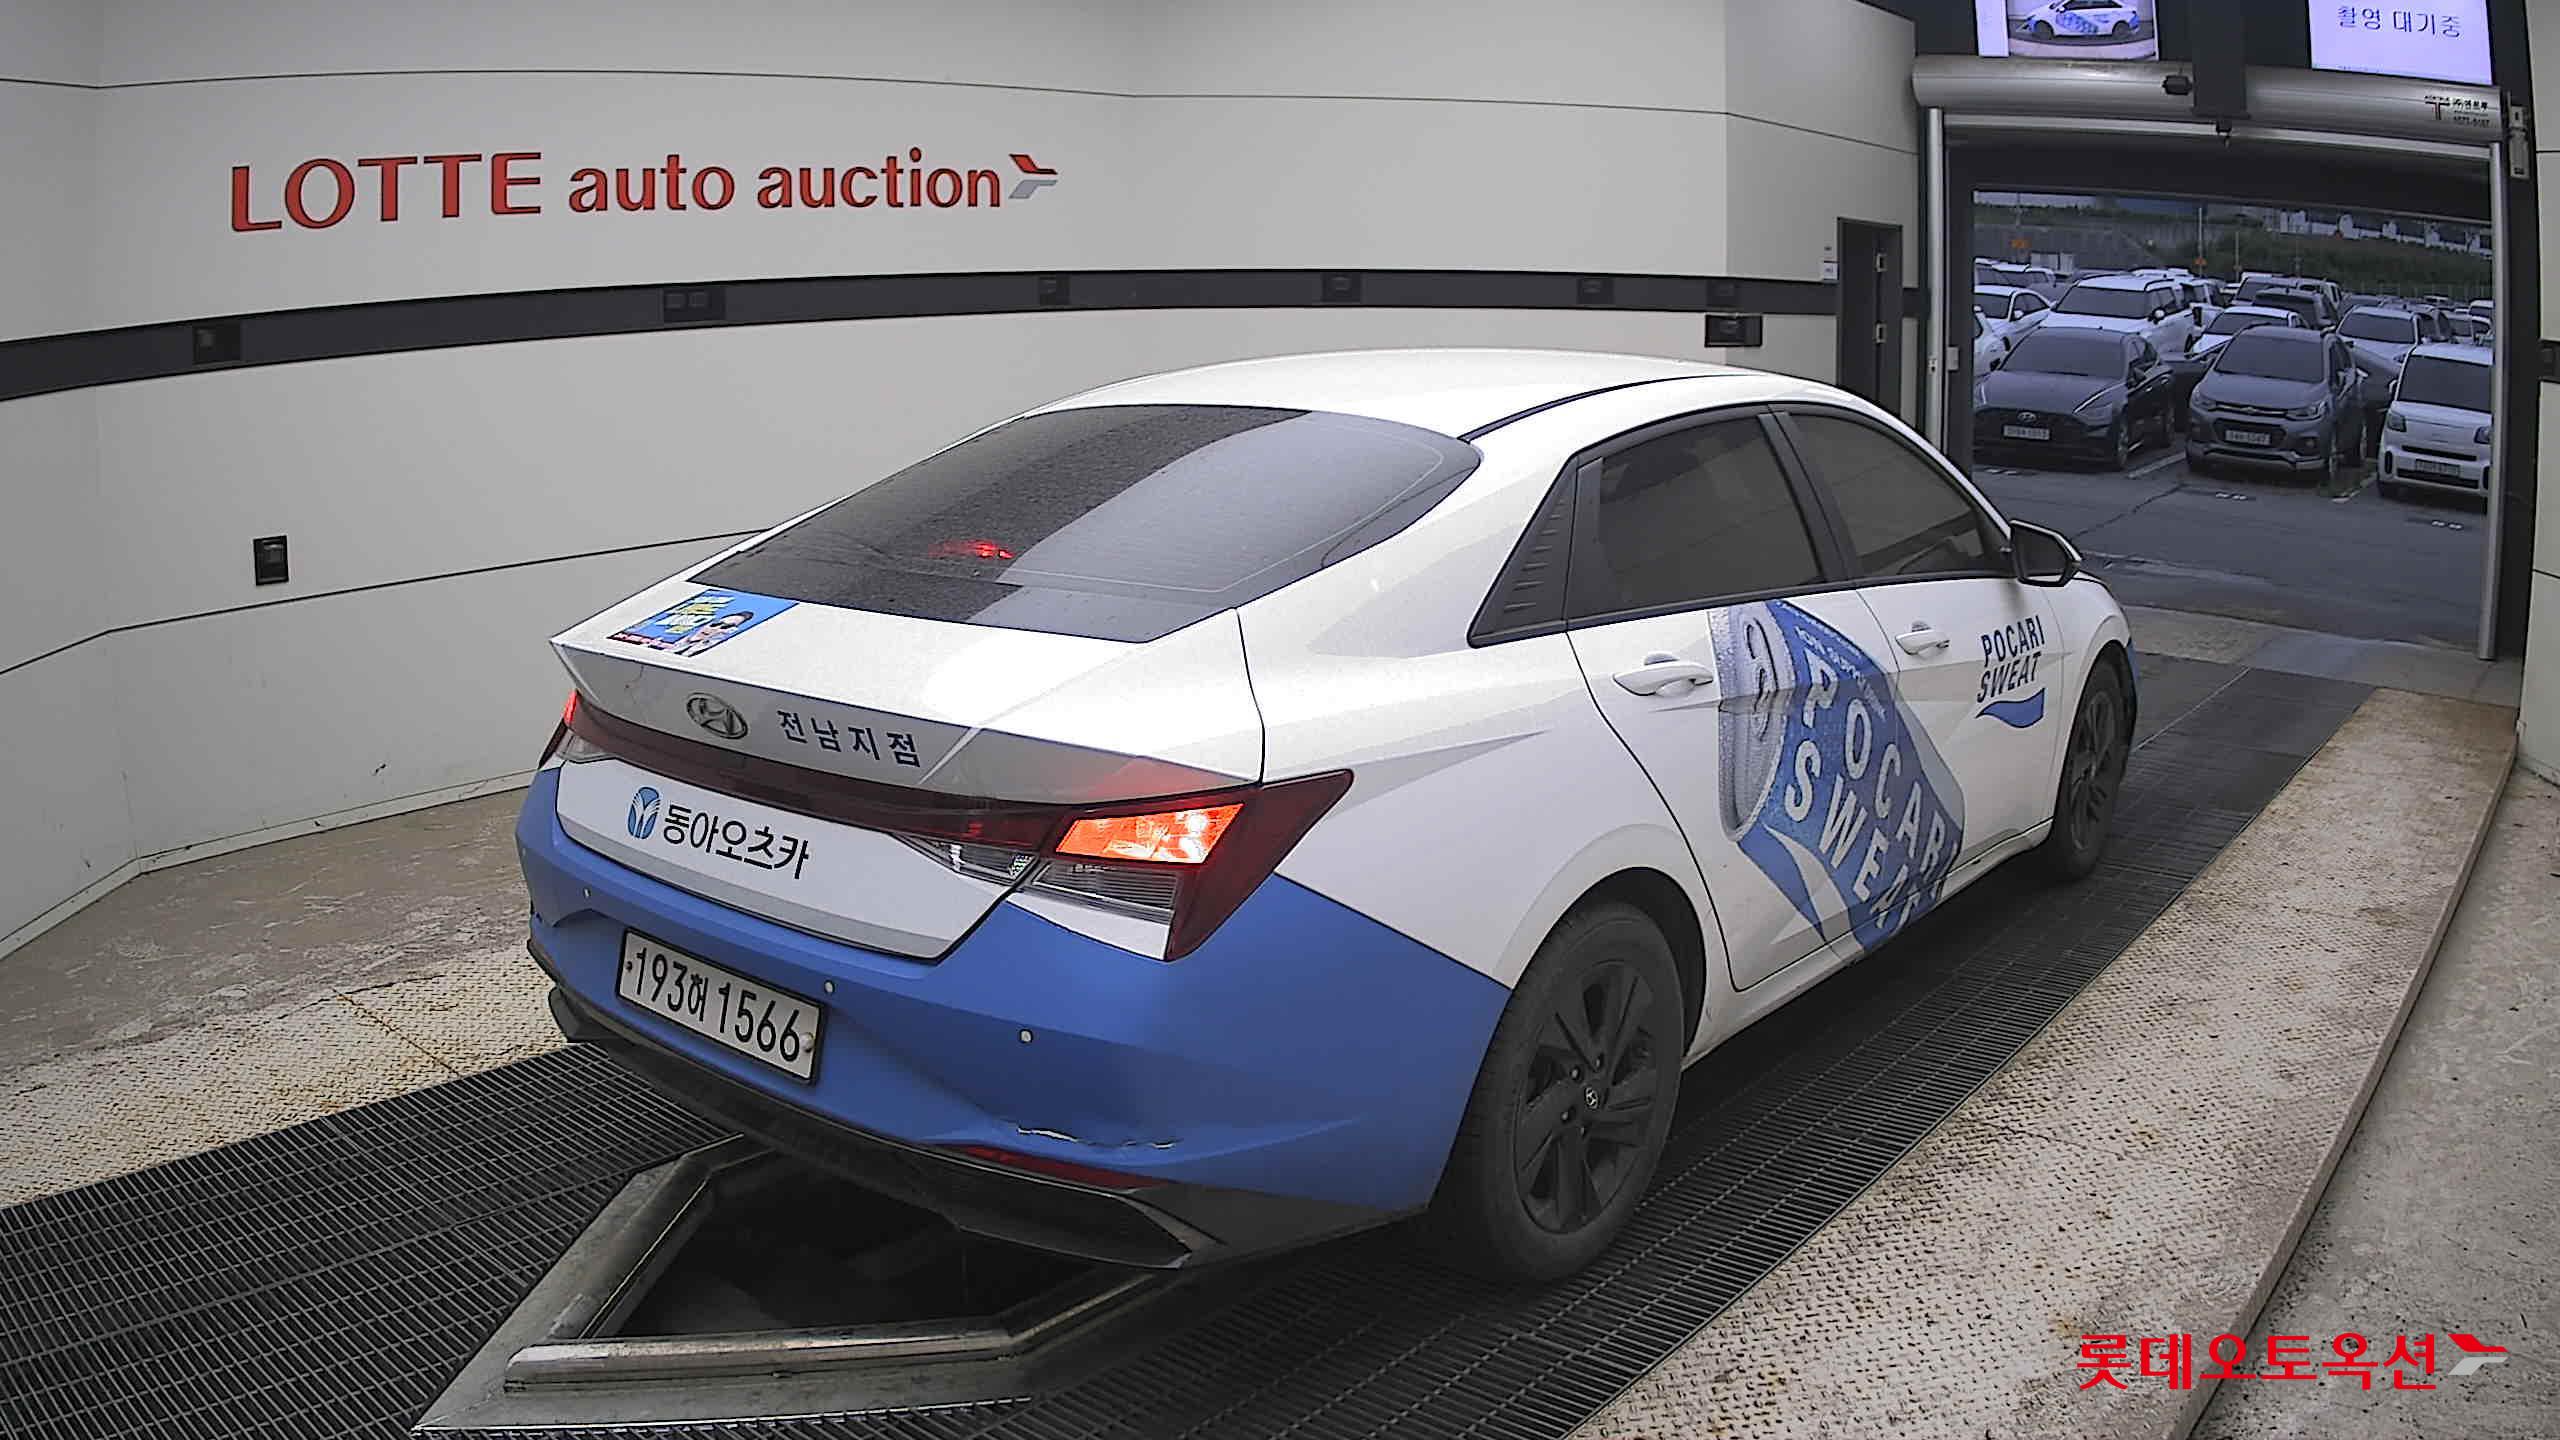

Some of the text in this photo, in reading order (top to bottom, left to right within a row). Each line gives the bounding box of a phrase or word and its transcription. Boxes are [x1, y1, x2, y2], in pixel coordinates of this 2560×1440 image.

[2338, 6, 2461, 38] 촬영 대기중
[231, 147, 1001, 232] LOTTE auto auction
[1980, 615, 2045, 668] POCARI
[1977, 651, 2042, 703] SWEAT
[776, 710, 920, 767] 전남지점
[663, 803, 810, 880] 동아오츠카
[1784, 739, 1922, 938] SWEAT
